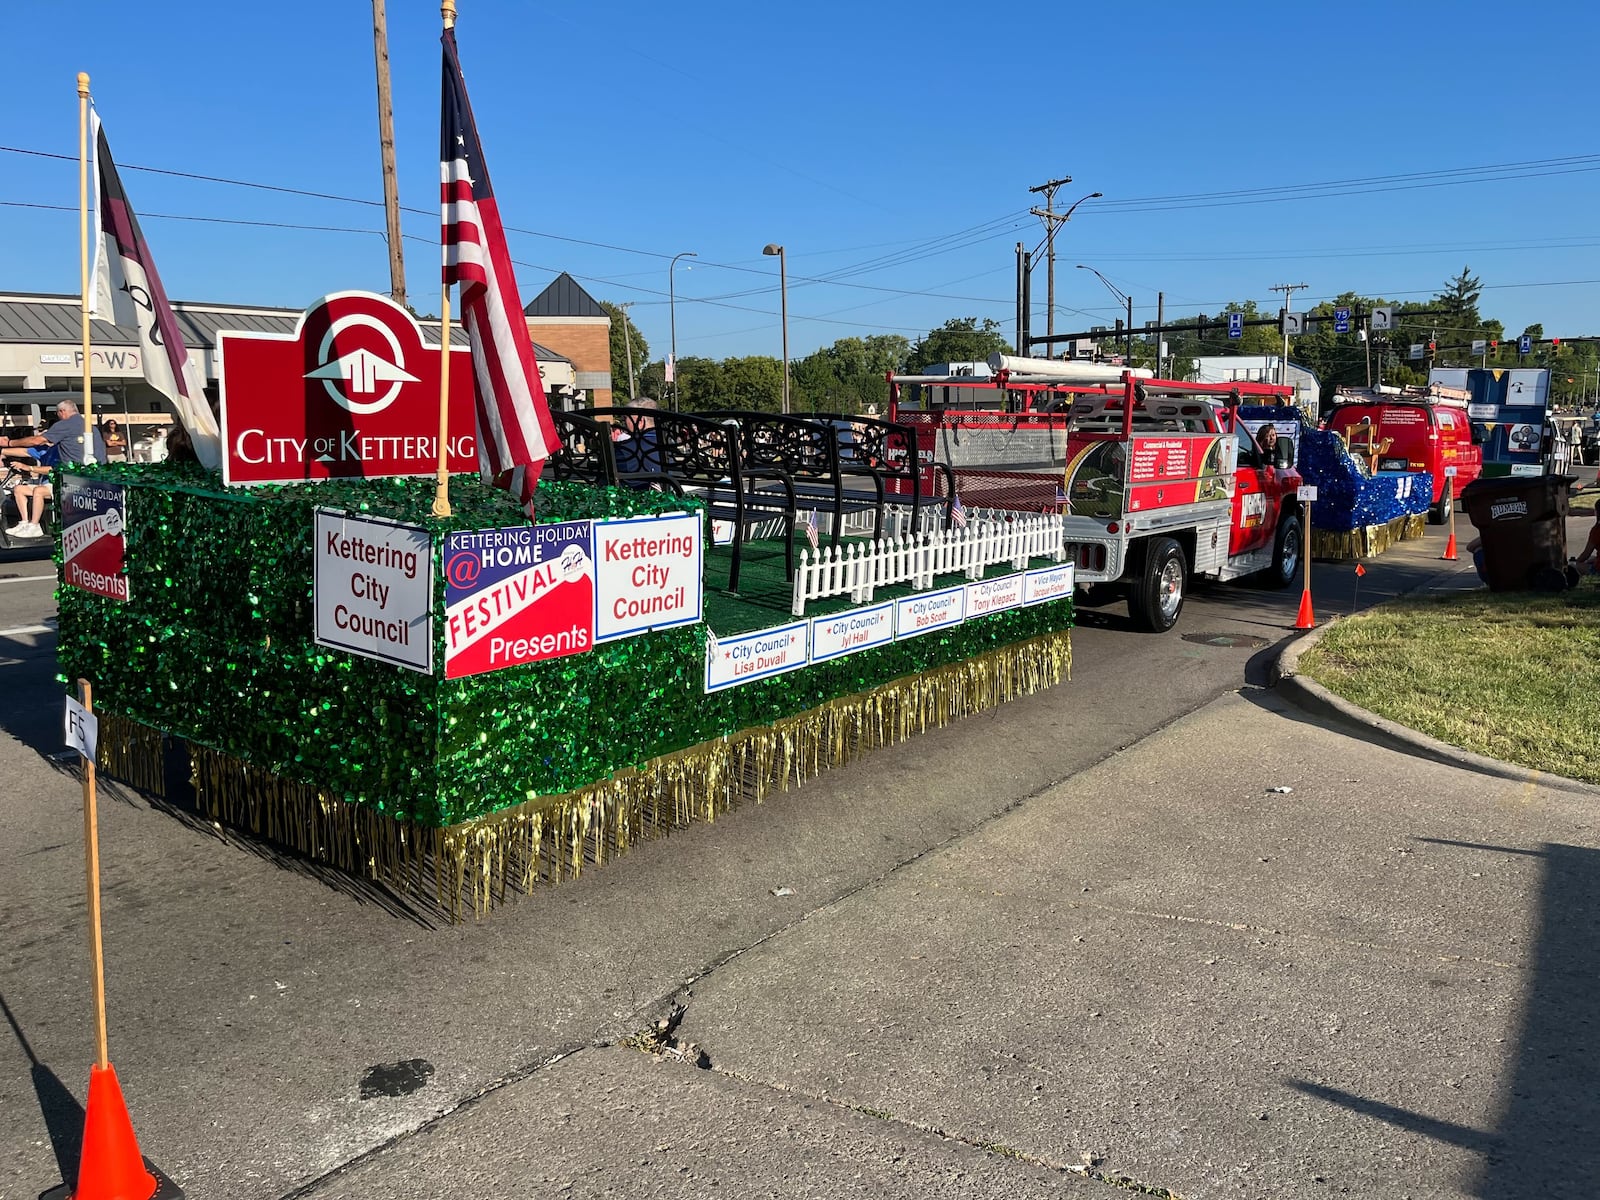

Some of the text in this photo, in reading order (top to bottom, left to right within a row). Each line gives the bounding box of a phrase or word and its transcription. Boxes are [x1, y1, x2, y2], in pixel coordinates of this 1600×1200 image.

[1230, 313, 1242, 328] H
[1336, 310, 1348, 319] 75
[236, 429, 475, 464] CITY OF KETTERING
[72, 495, 97, 511] HOME
[93, 489, 123, 502] HOLIDAY
[1299, 489, 1309, 497] F4
[63, 517, 105, 557] FESTIVAL
[450, 525, 588, 551] KETTERING HOLIDAY
[604, 534, 693, 563] Kettering
[327, 530, 418, 580] Kettering
[446, 544, 543, 590] @ HOME
[72, 562, 126, 596] Presents
[350, 571, 390, 610] City
[631, 566, 671, 589] City
[980, 580, 1013, 596] City Council
[449, 562, 557, 640] FESTIVAL
[612, 586, 685, 620] Council
[912, 598, 952, 615] City Council
[974, 598, 991, 611] Tony
[334, 604, 409, 647] Council
[832, 613, 880, 636] City Council
[916, 611, 947, 627] Bob Scott
[489, 624, 588, 664] Presents
[732, 634, 790, 660] City Council
[841, 629, 869, 648] Jyl Hall
[734, 651, 786, 676] Lisa Duvall
[69, 709, 86, 742] F5
